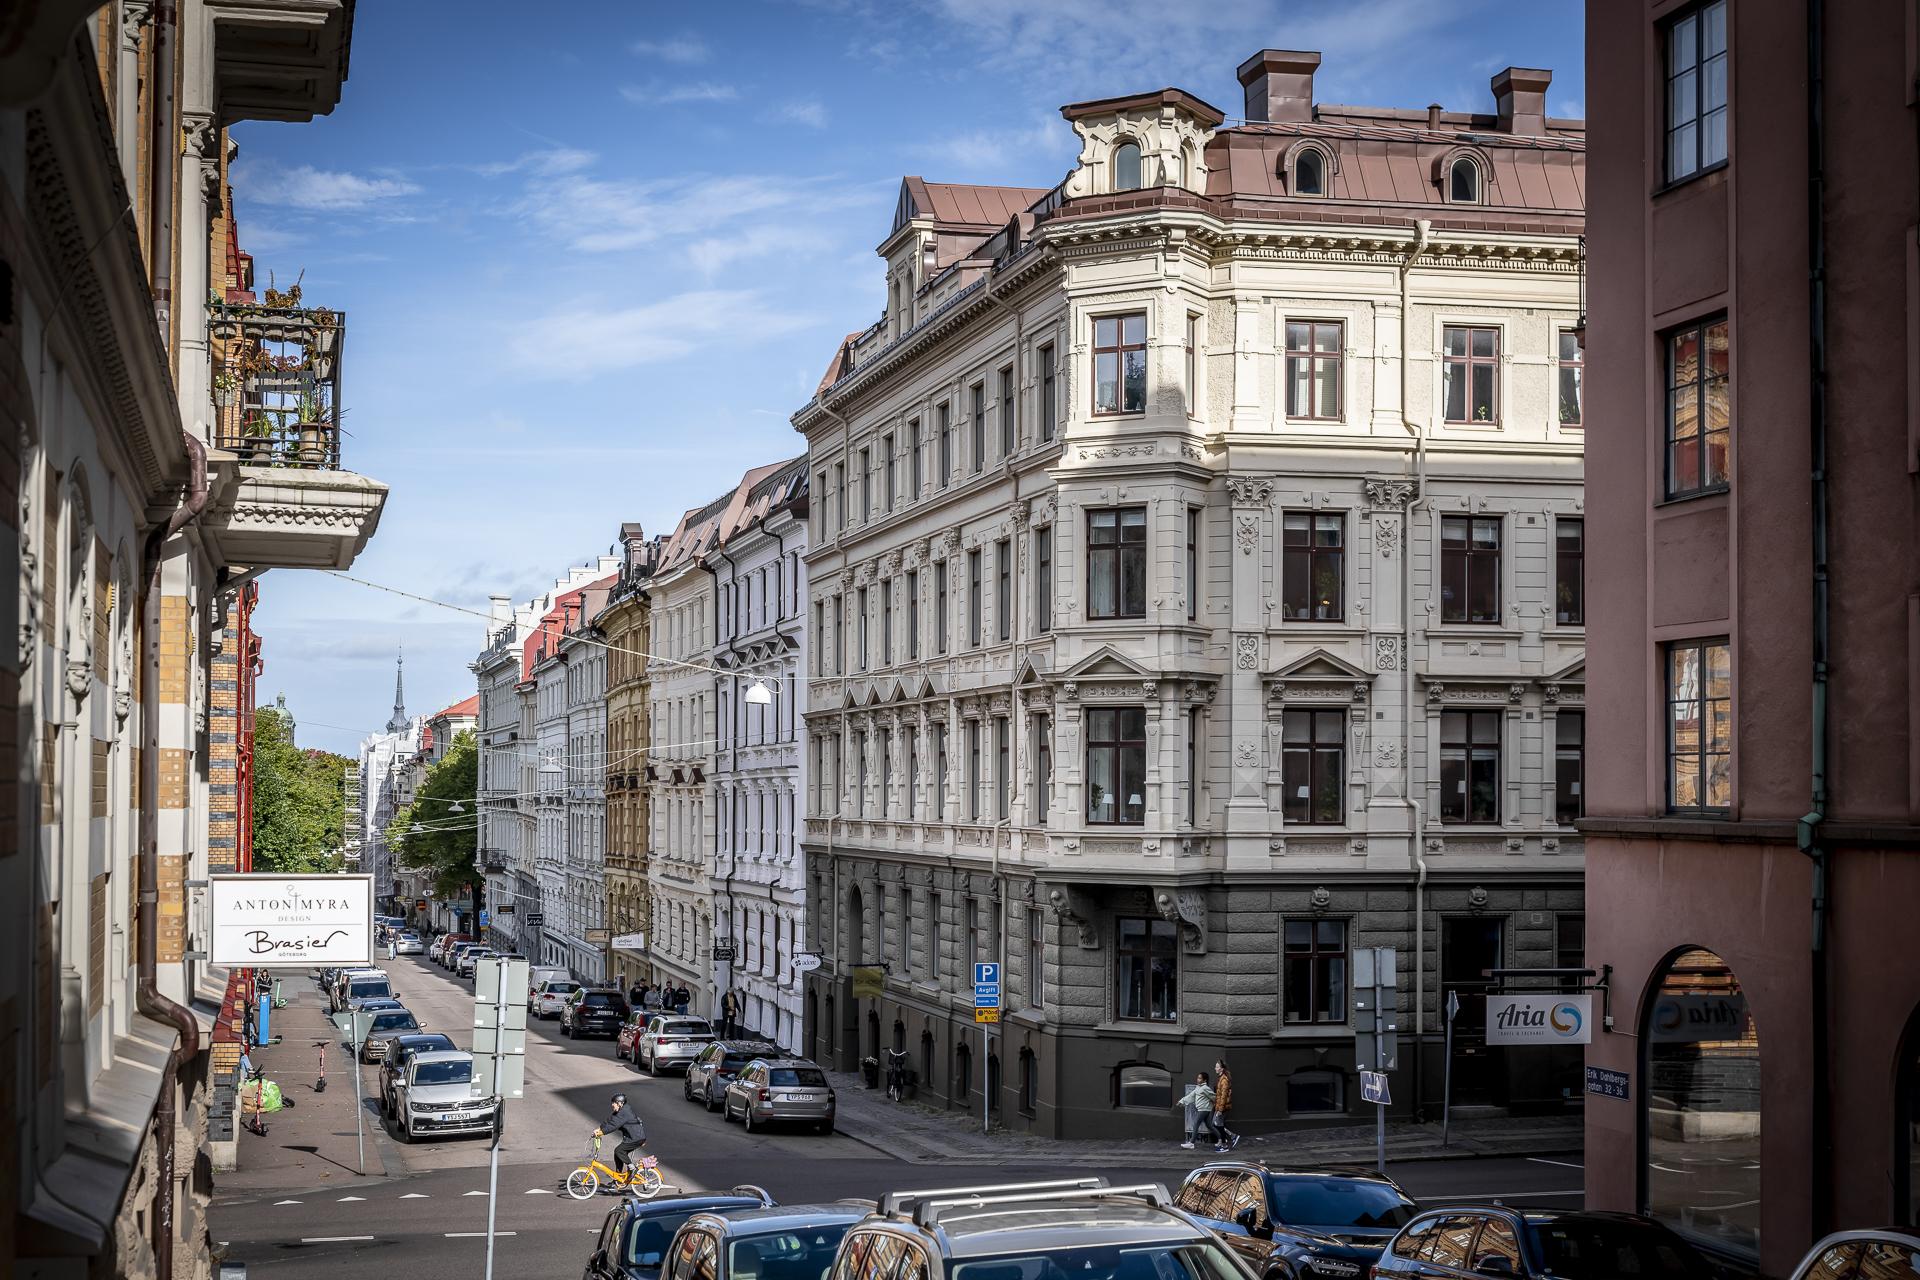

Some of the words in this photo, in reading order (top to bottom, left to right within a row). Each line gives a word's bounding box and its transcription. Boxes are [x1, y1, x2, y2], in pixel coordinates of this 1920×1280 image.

[233, 899, 292, 910] ANTON
[301, 898, 350, 910] MYRA
[245, 930, 349, 954] Brasier
[982, 965, 994, 982] P
[1496, 1003, 1545, 1029] Aria
[1587, 1069, 1598, 1080] Erik
[1587, 1082, 1603, 1092] gatan
